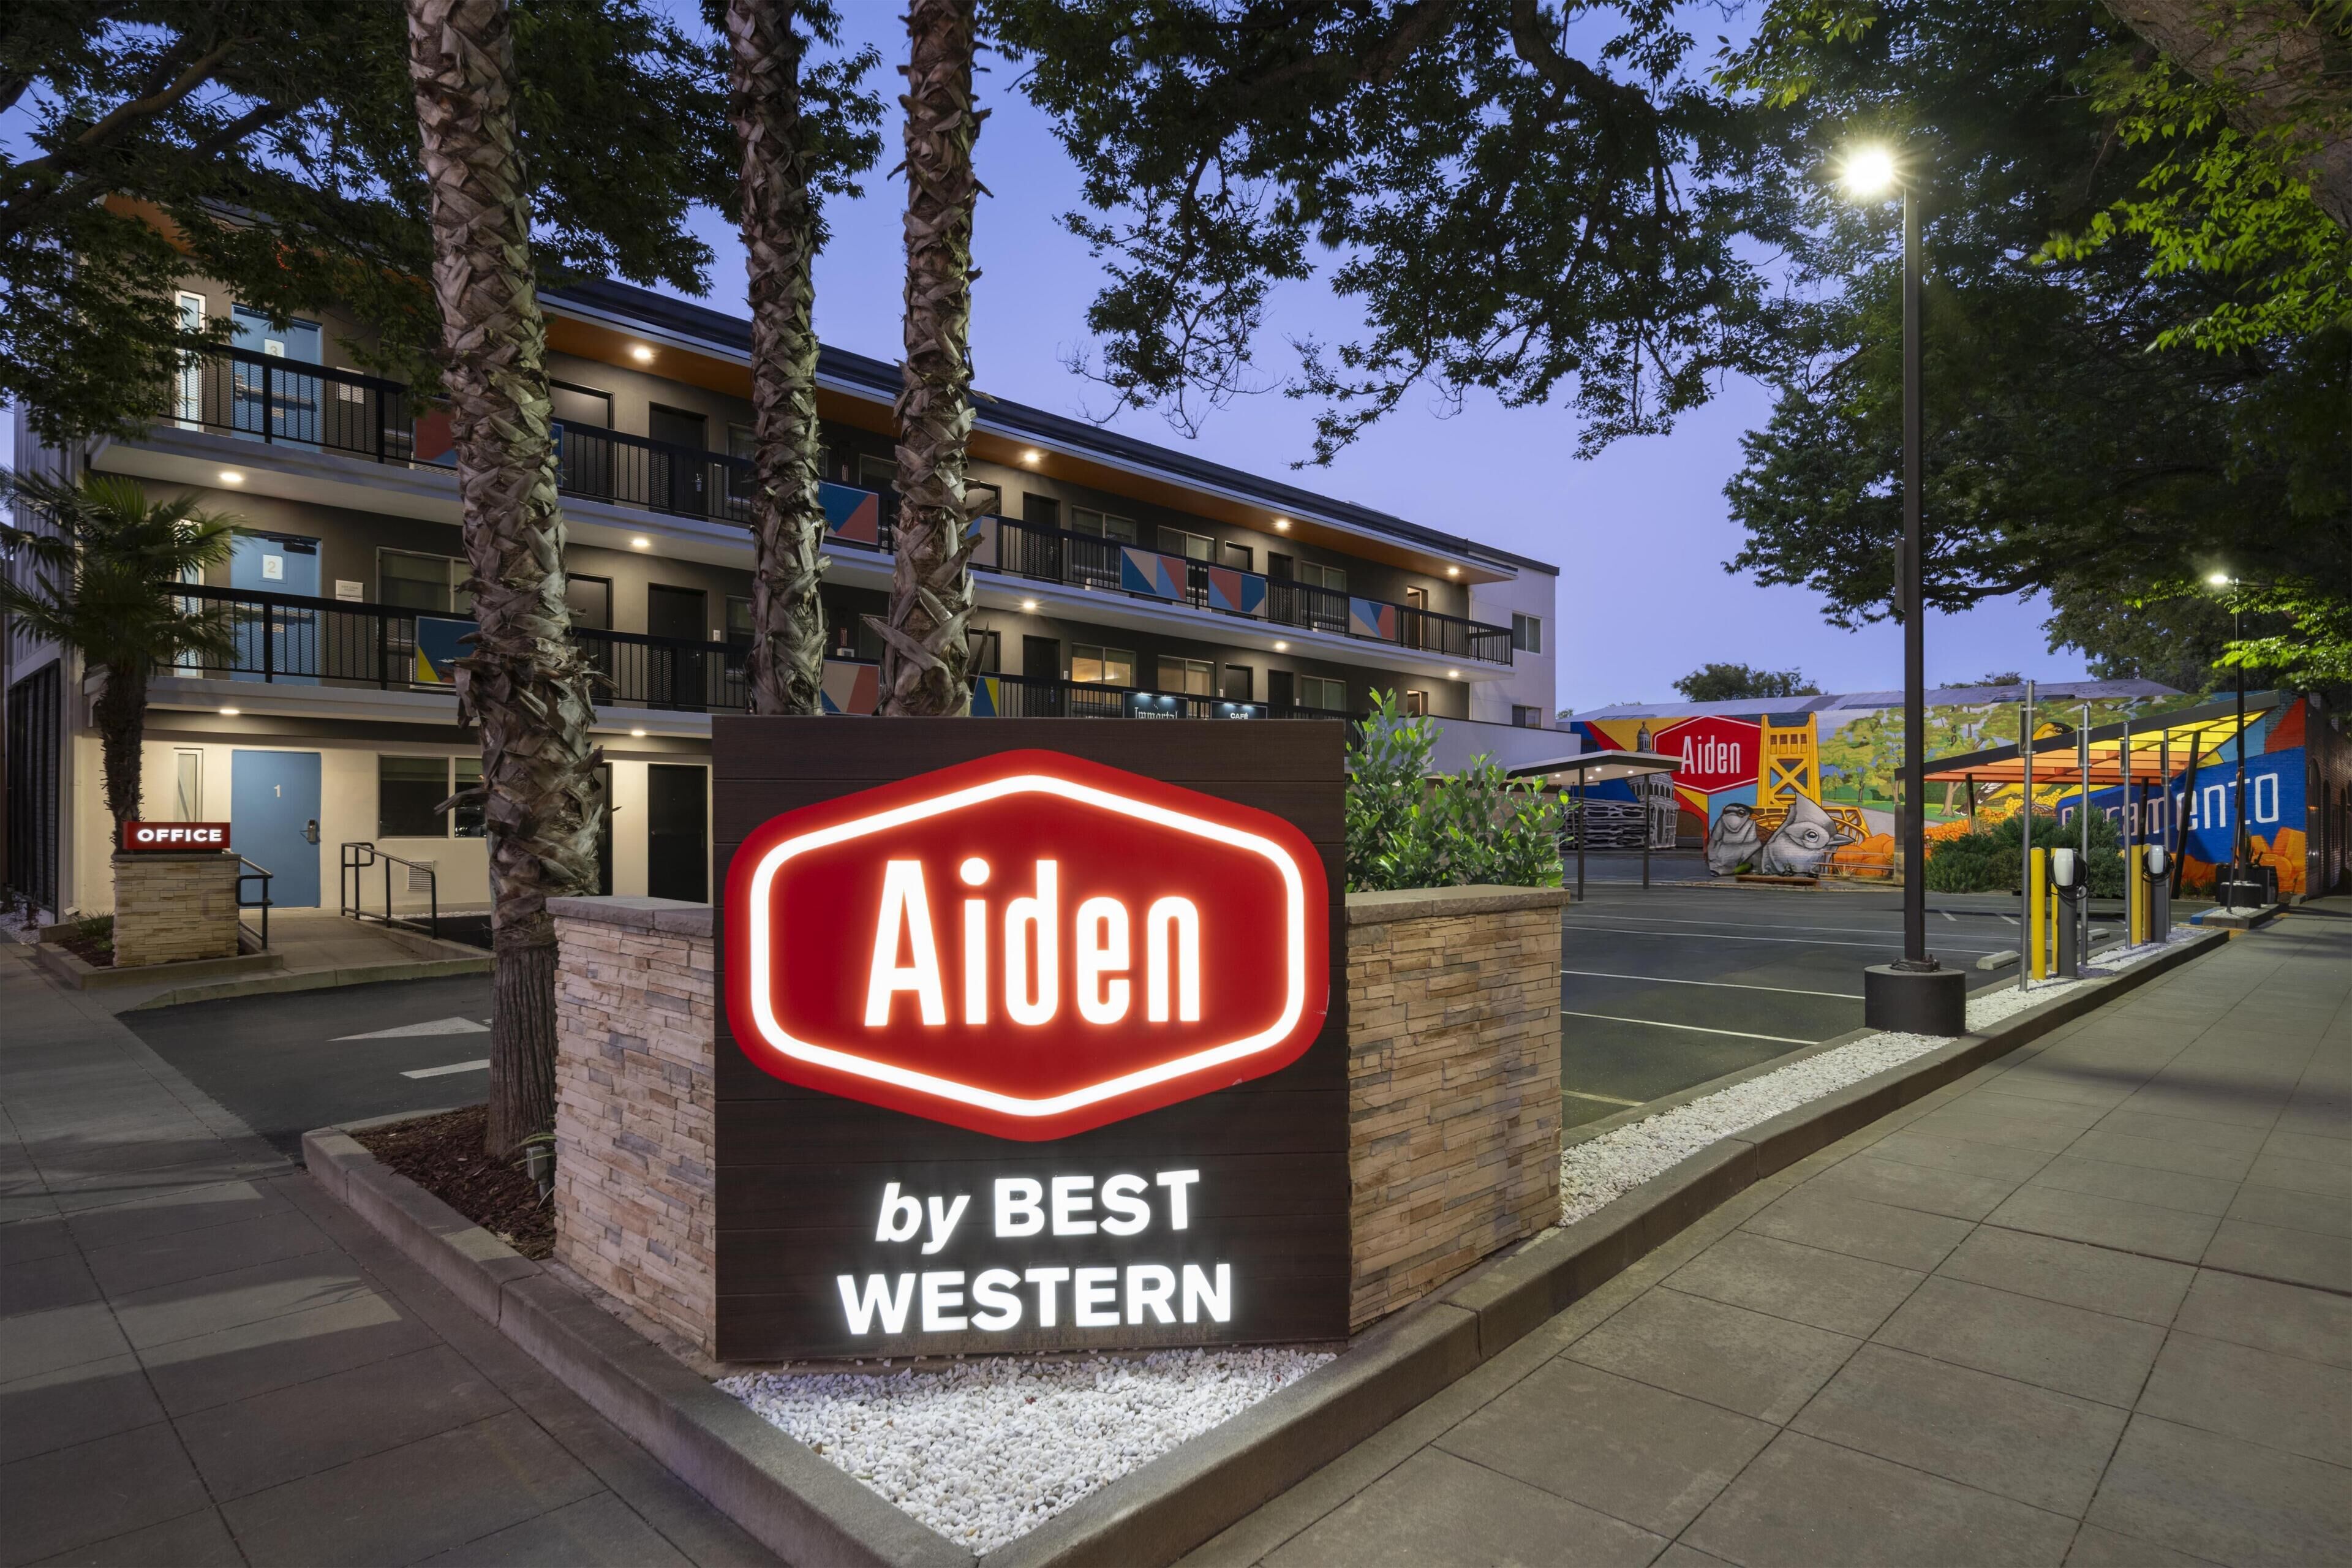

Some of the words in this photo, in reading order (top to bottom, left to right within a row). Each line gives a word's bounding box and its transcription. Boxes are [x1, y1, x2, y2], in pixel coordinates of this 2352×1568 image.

[268, 561, 276, 573] 2
[1680, 735, 1740, 774] Aiden
[274, 784, 281, 797] 1
[137, 829, 222, 842] OFFICE
[864, 857, 1200, 1027] Aiden
[875, 1182, 971, 1254] by
[994, 1169, 1199, 1238] BEST
[837, 1263, 1231, 1335] WESTERN
